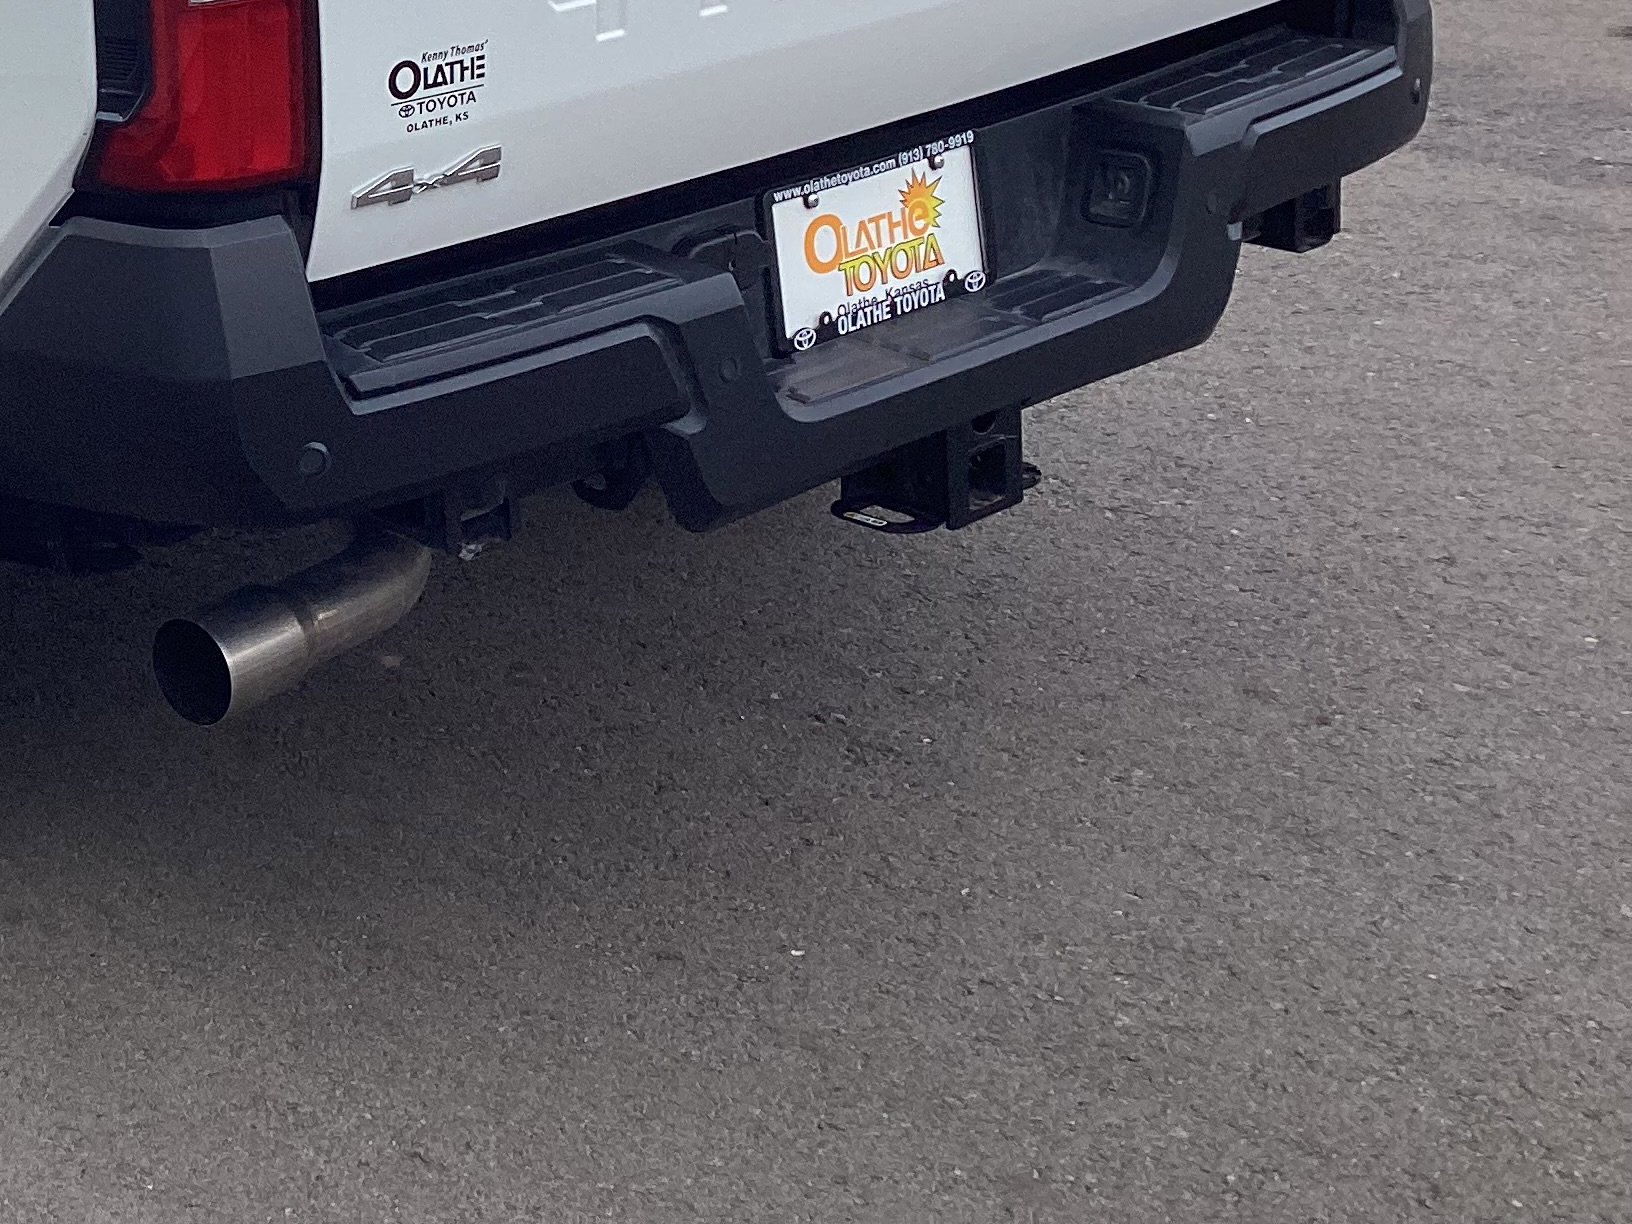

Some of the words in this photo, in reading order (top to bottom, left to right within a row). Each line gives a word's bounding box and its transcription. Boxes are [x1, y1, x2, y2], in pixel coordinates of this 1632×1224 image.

[421, 47, 449, 64] Kenny
[388, 54, 486, 100] OLATHE
[416, 90, 477, 115] TOYOTA
[406, 116, 453, 133] OLATHE,
[455, 111, 469, 123] KS
[773, 159, 897, 203] www.olathetoyota.com
[898, 147, 924, 168] (913)
[926, 130, 975, 156] 780-9919
[838, 233, 945, 296] TOYOTA
[885, 279, 929, 300] Kansas
[838, 300, 892, 335] OLATHE
[894, 283, 946, 316] TOYOTA
